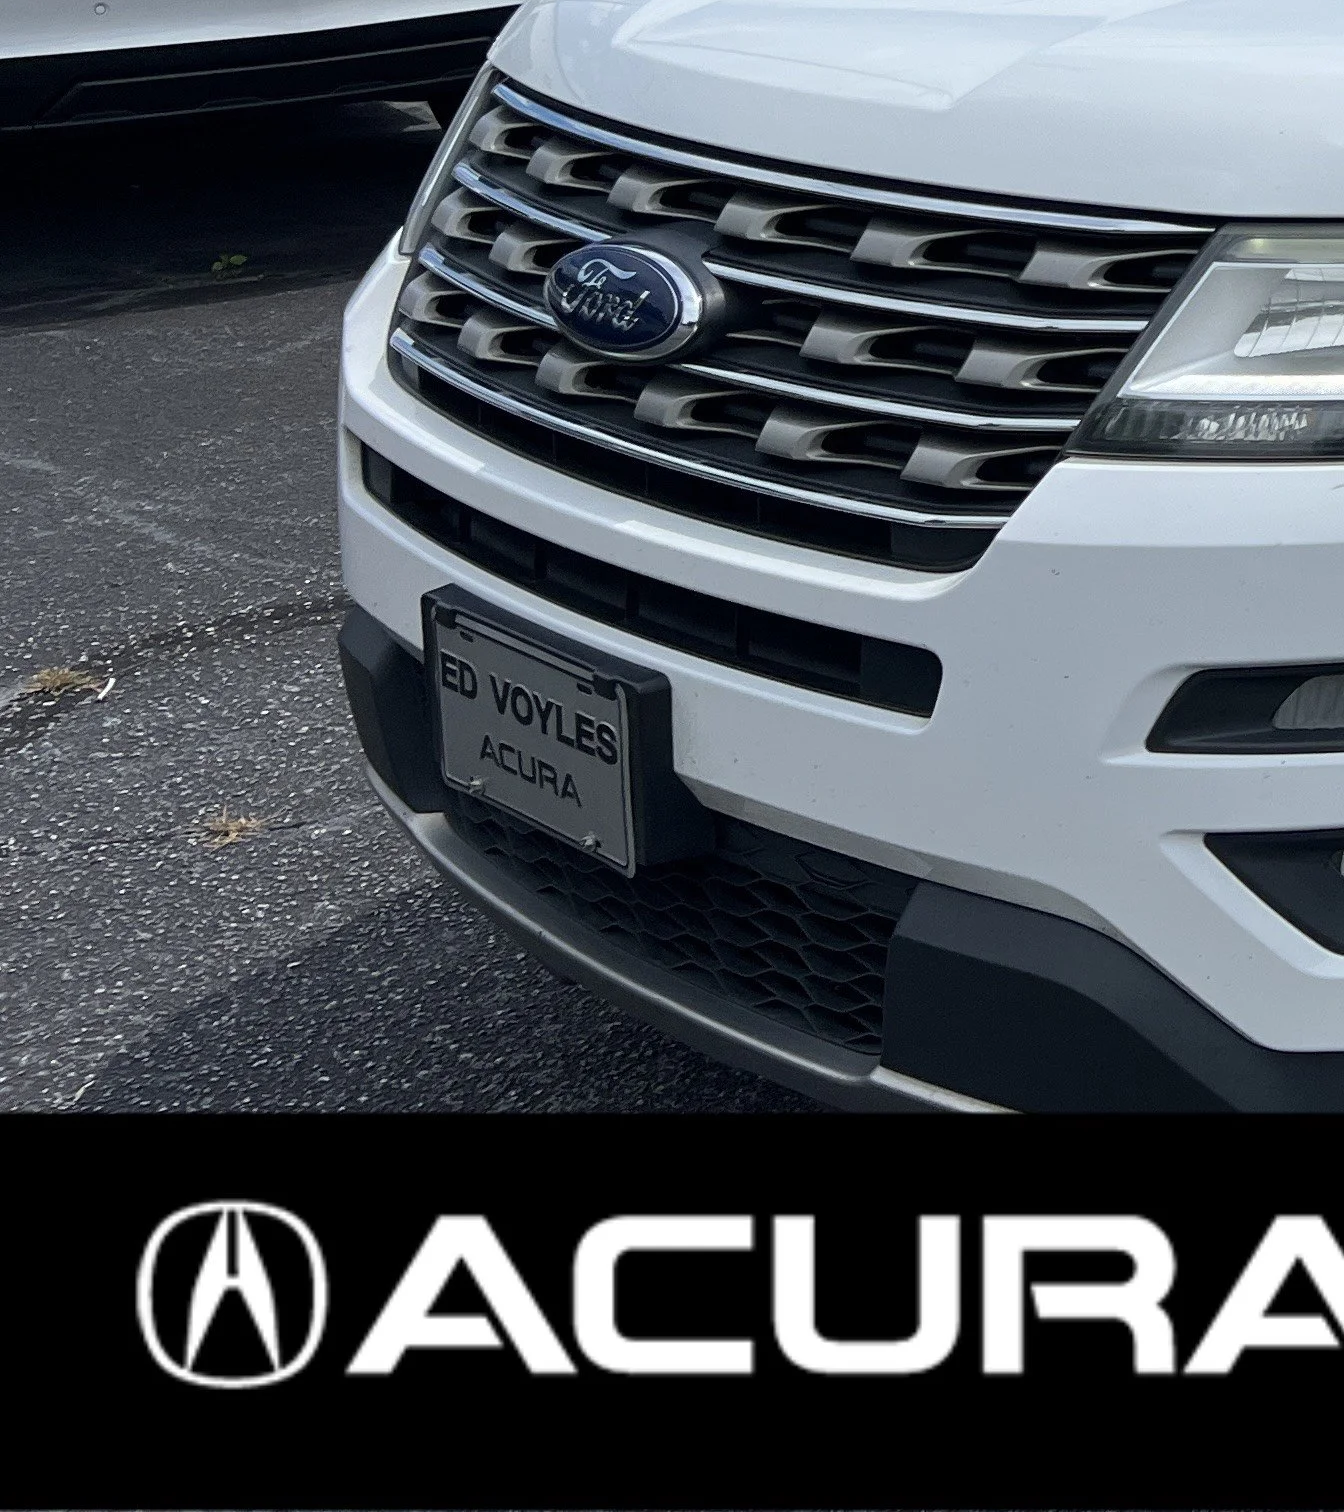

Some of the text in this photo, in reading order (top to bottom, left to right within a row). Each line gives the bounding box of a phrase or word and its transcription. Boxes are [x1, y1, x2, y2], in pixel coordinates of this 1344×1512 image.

[561, 258, 650, 333] Ford
[440, 648, 619, 766] ED VOYLES
[479, 734, 583, 809] ACURA
